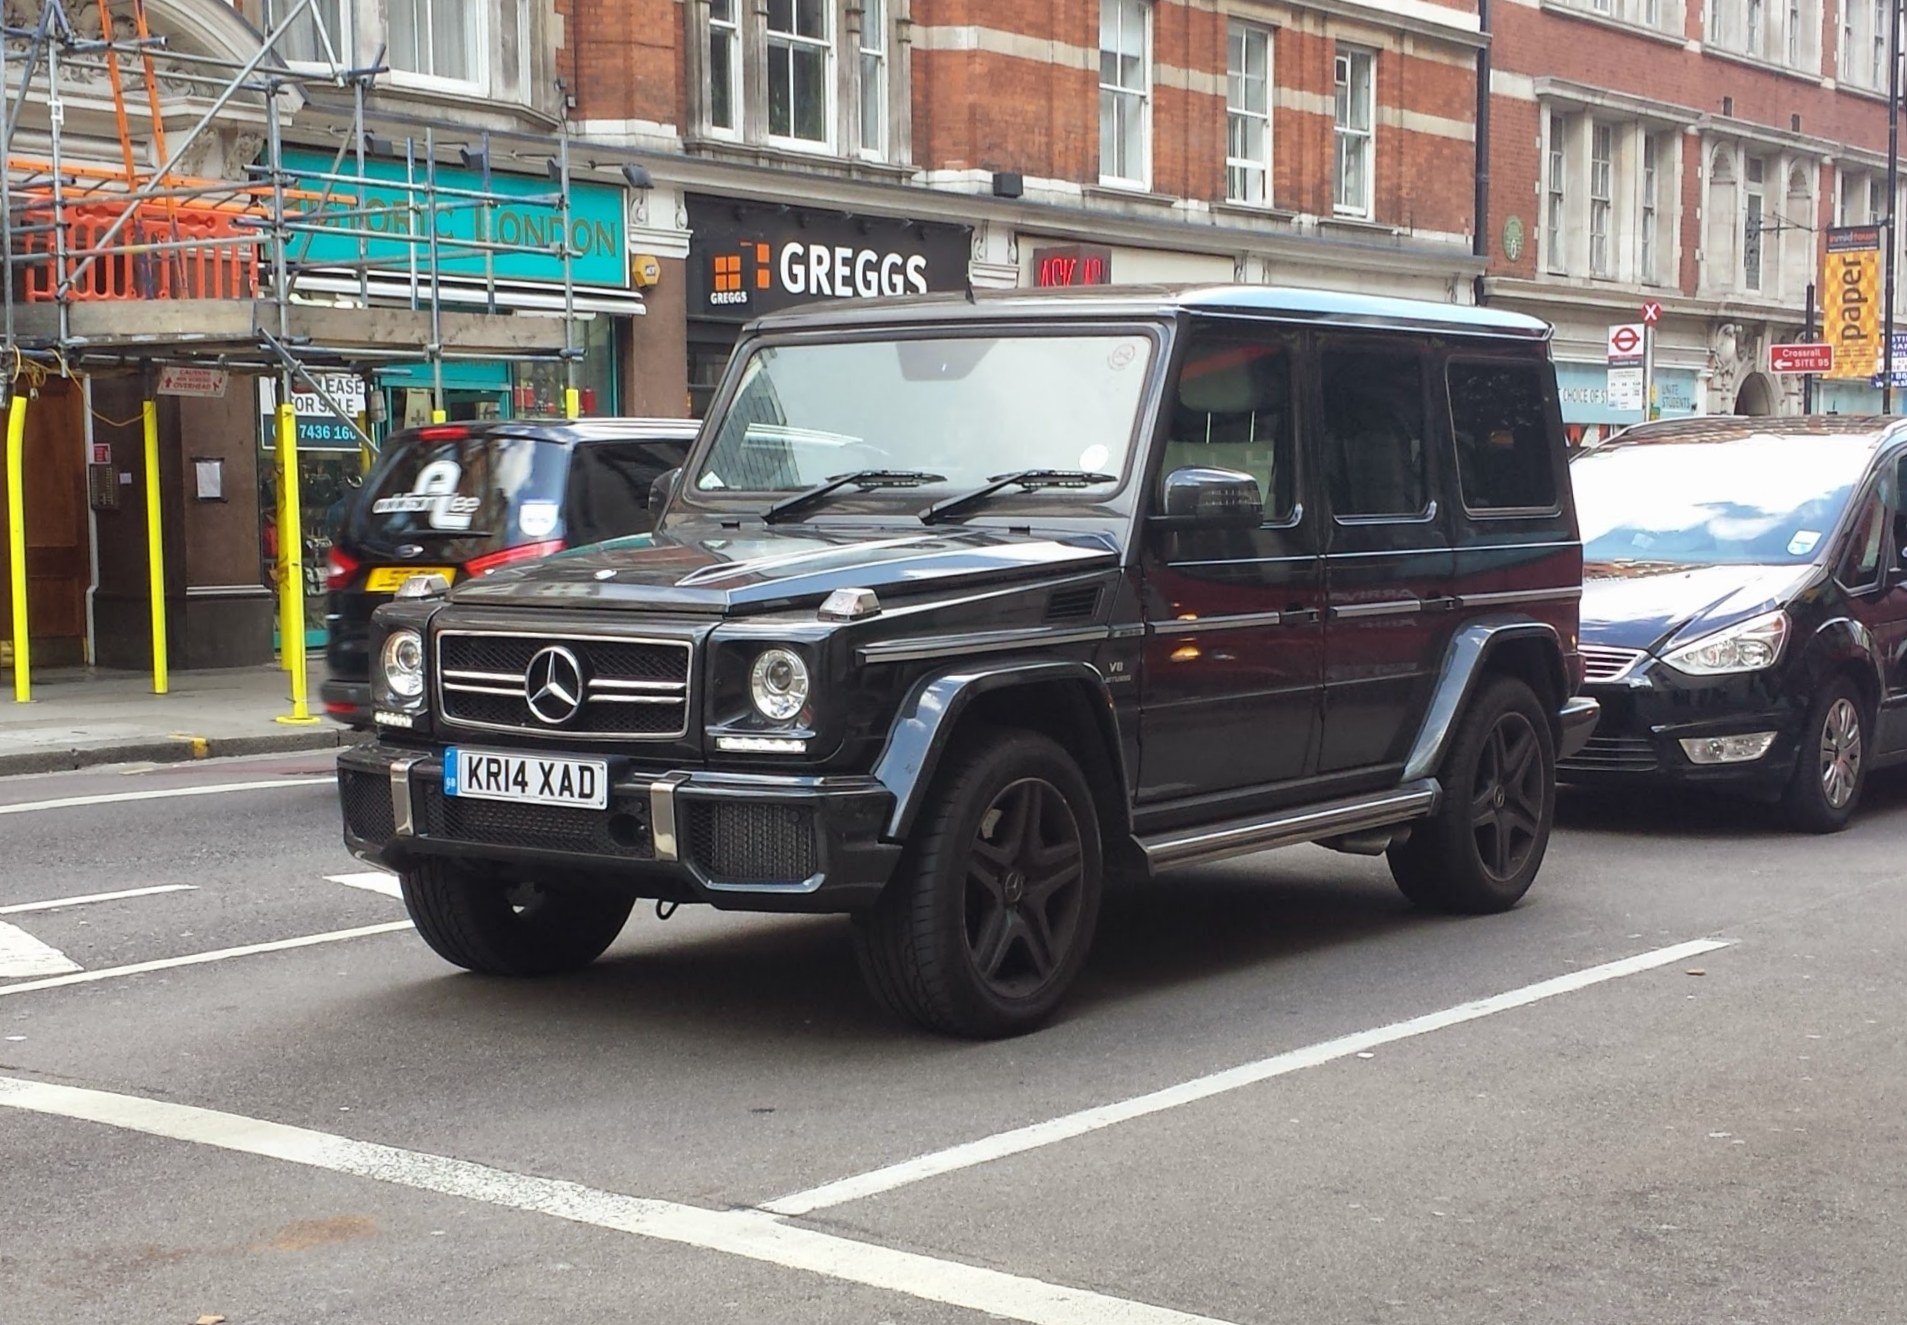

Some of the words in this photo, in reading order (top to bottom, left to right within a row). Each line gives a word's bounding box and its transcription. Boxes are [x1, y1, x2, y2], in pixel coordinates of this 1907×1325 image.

[780, 241, 927, 297] GREGGS
[710, 291, 747, 304] GREGGS
[1841, 257, 1868, 341] paper
[1782, 349, 1821, 357] Crossrail
[1817, 359, 1829, 367] 95
[1563, 387, 1588, 403] CHOICE
[1661, 384, 1679, 395] UNITE
[1662, 397, 1690, 409] STUDENTS
[300, 424, 331, 439] 7436
[467, 756, 529, 794] KR14
[538, 761, 596, 800] XAD
